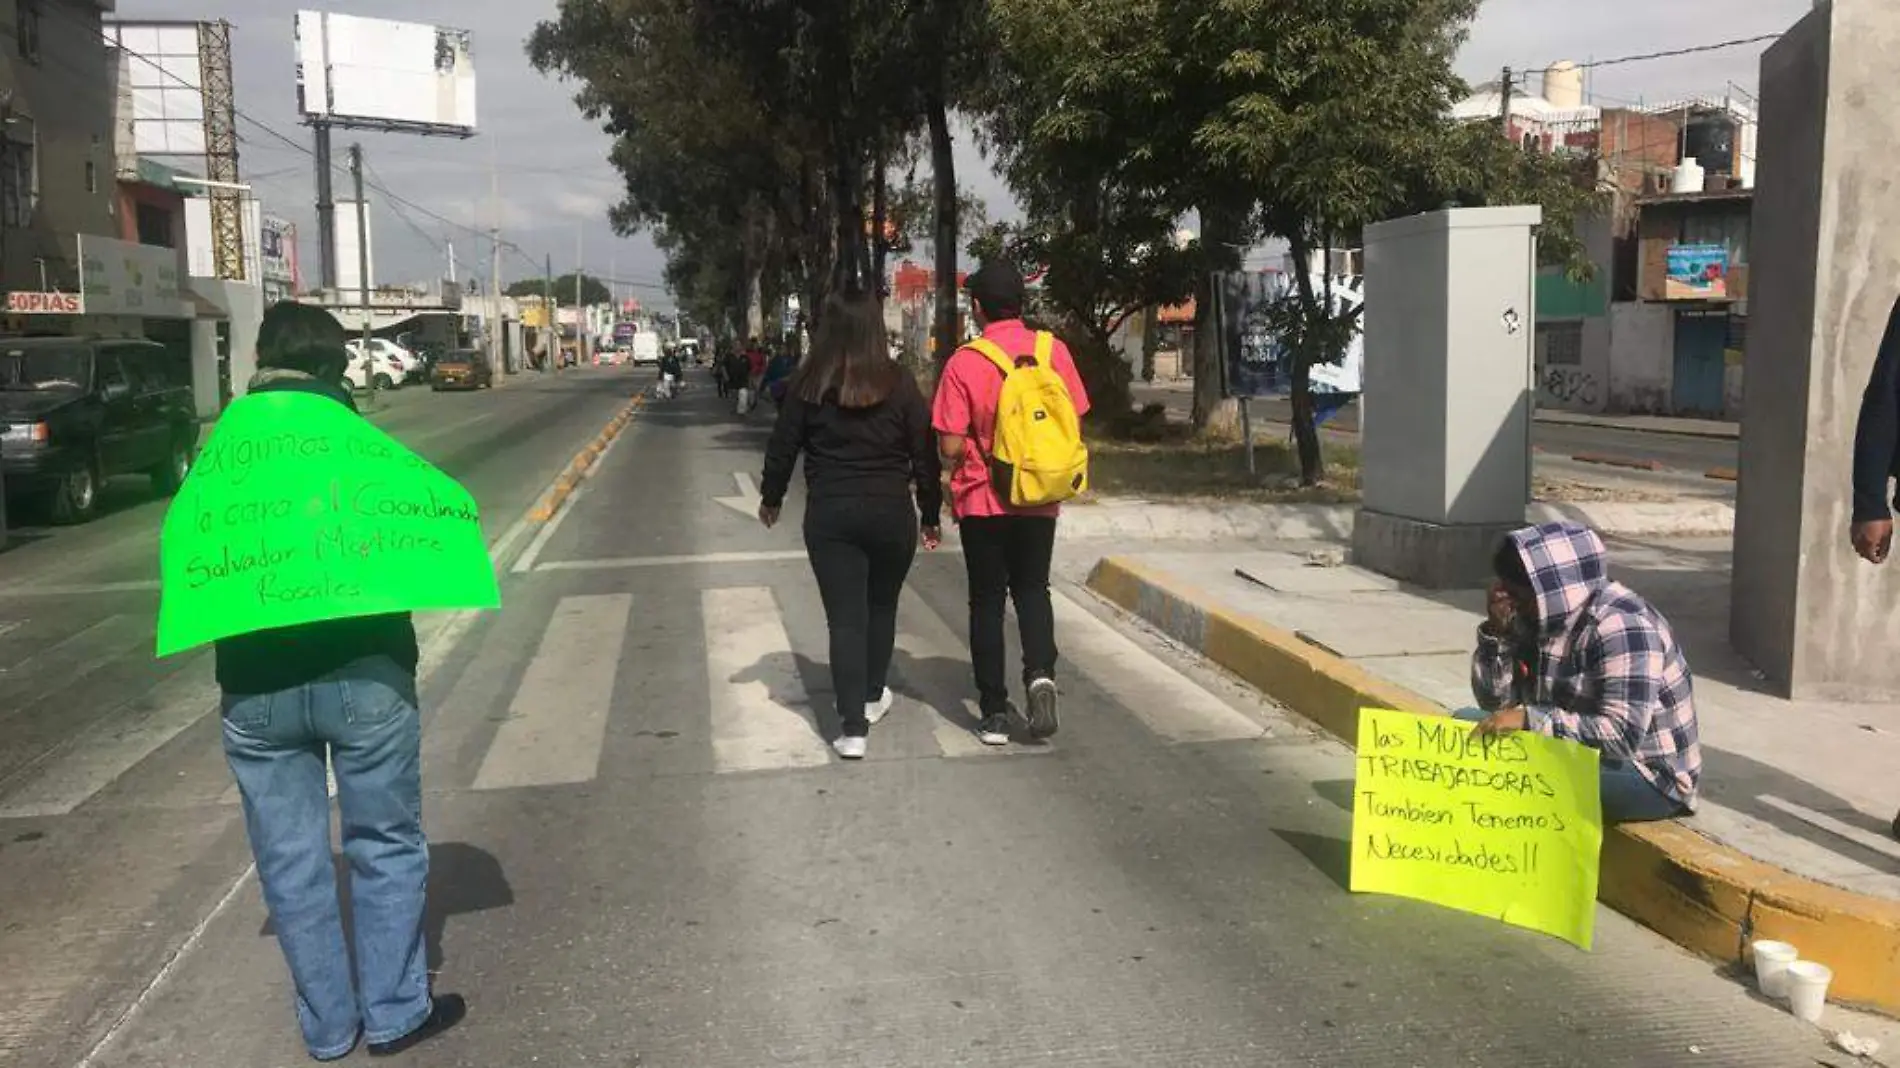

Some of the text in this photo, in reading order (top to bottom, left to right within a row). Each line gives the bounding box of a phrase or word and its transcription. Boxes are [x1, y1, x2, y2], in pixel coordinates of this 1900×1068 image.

[186, 538, 295, 588] Salvador
[1359, 755, 1555, 797] TRABAJADORAS
[1361, 791, 1566, 832] Tambien Tenemos
